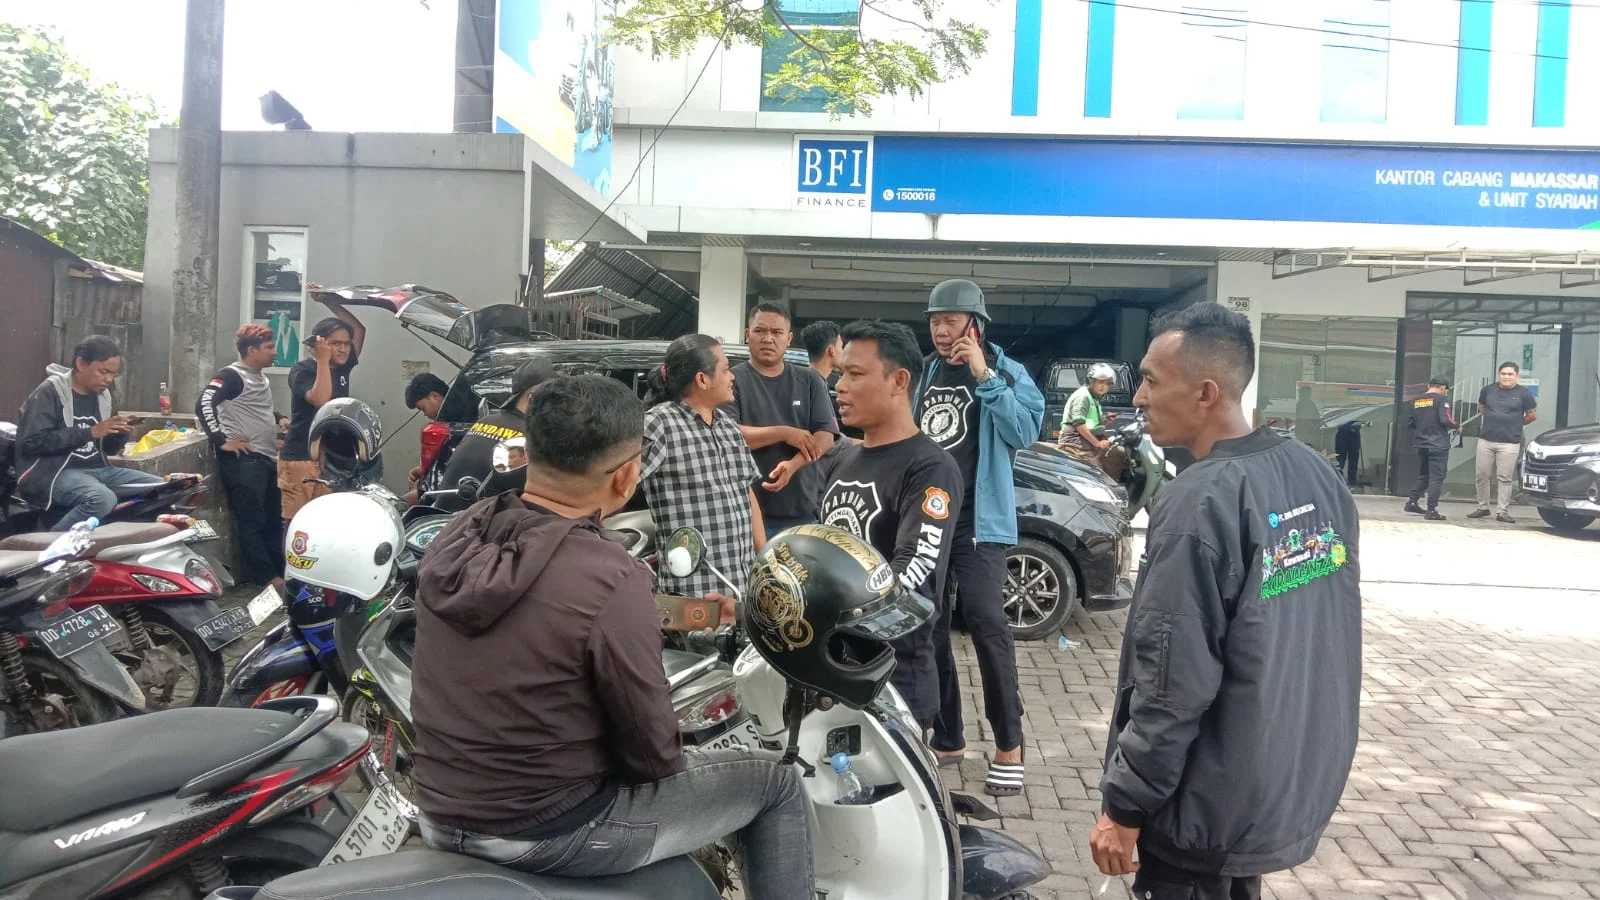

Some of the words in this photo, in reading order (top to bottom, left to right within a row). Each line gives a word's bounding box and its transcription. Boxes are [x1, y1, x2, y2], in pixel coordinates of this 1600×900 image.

[802, 148, 864, 187] BFI
[1375, 169, 1435, 185] KANTOR
[1442, 171, 1503, 187] CABANG
[1510, 172, 1599, 190] MAKASSAR
[797, 197, 866, 208] FINANCE
[896, 192, 936, 201] 1500018
[1478, 191, 1491, 207] &
[1494, 192, 1528, 208] UNIT
[1535, 193, 1598, 209] SYARIAH
[41, 628, 60, 643] DD
[345, 815, 378, 857] 5701
